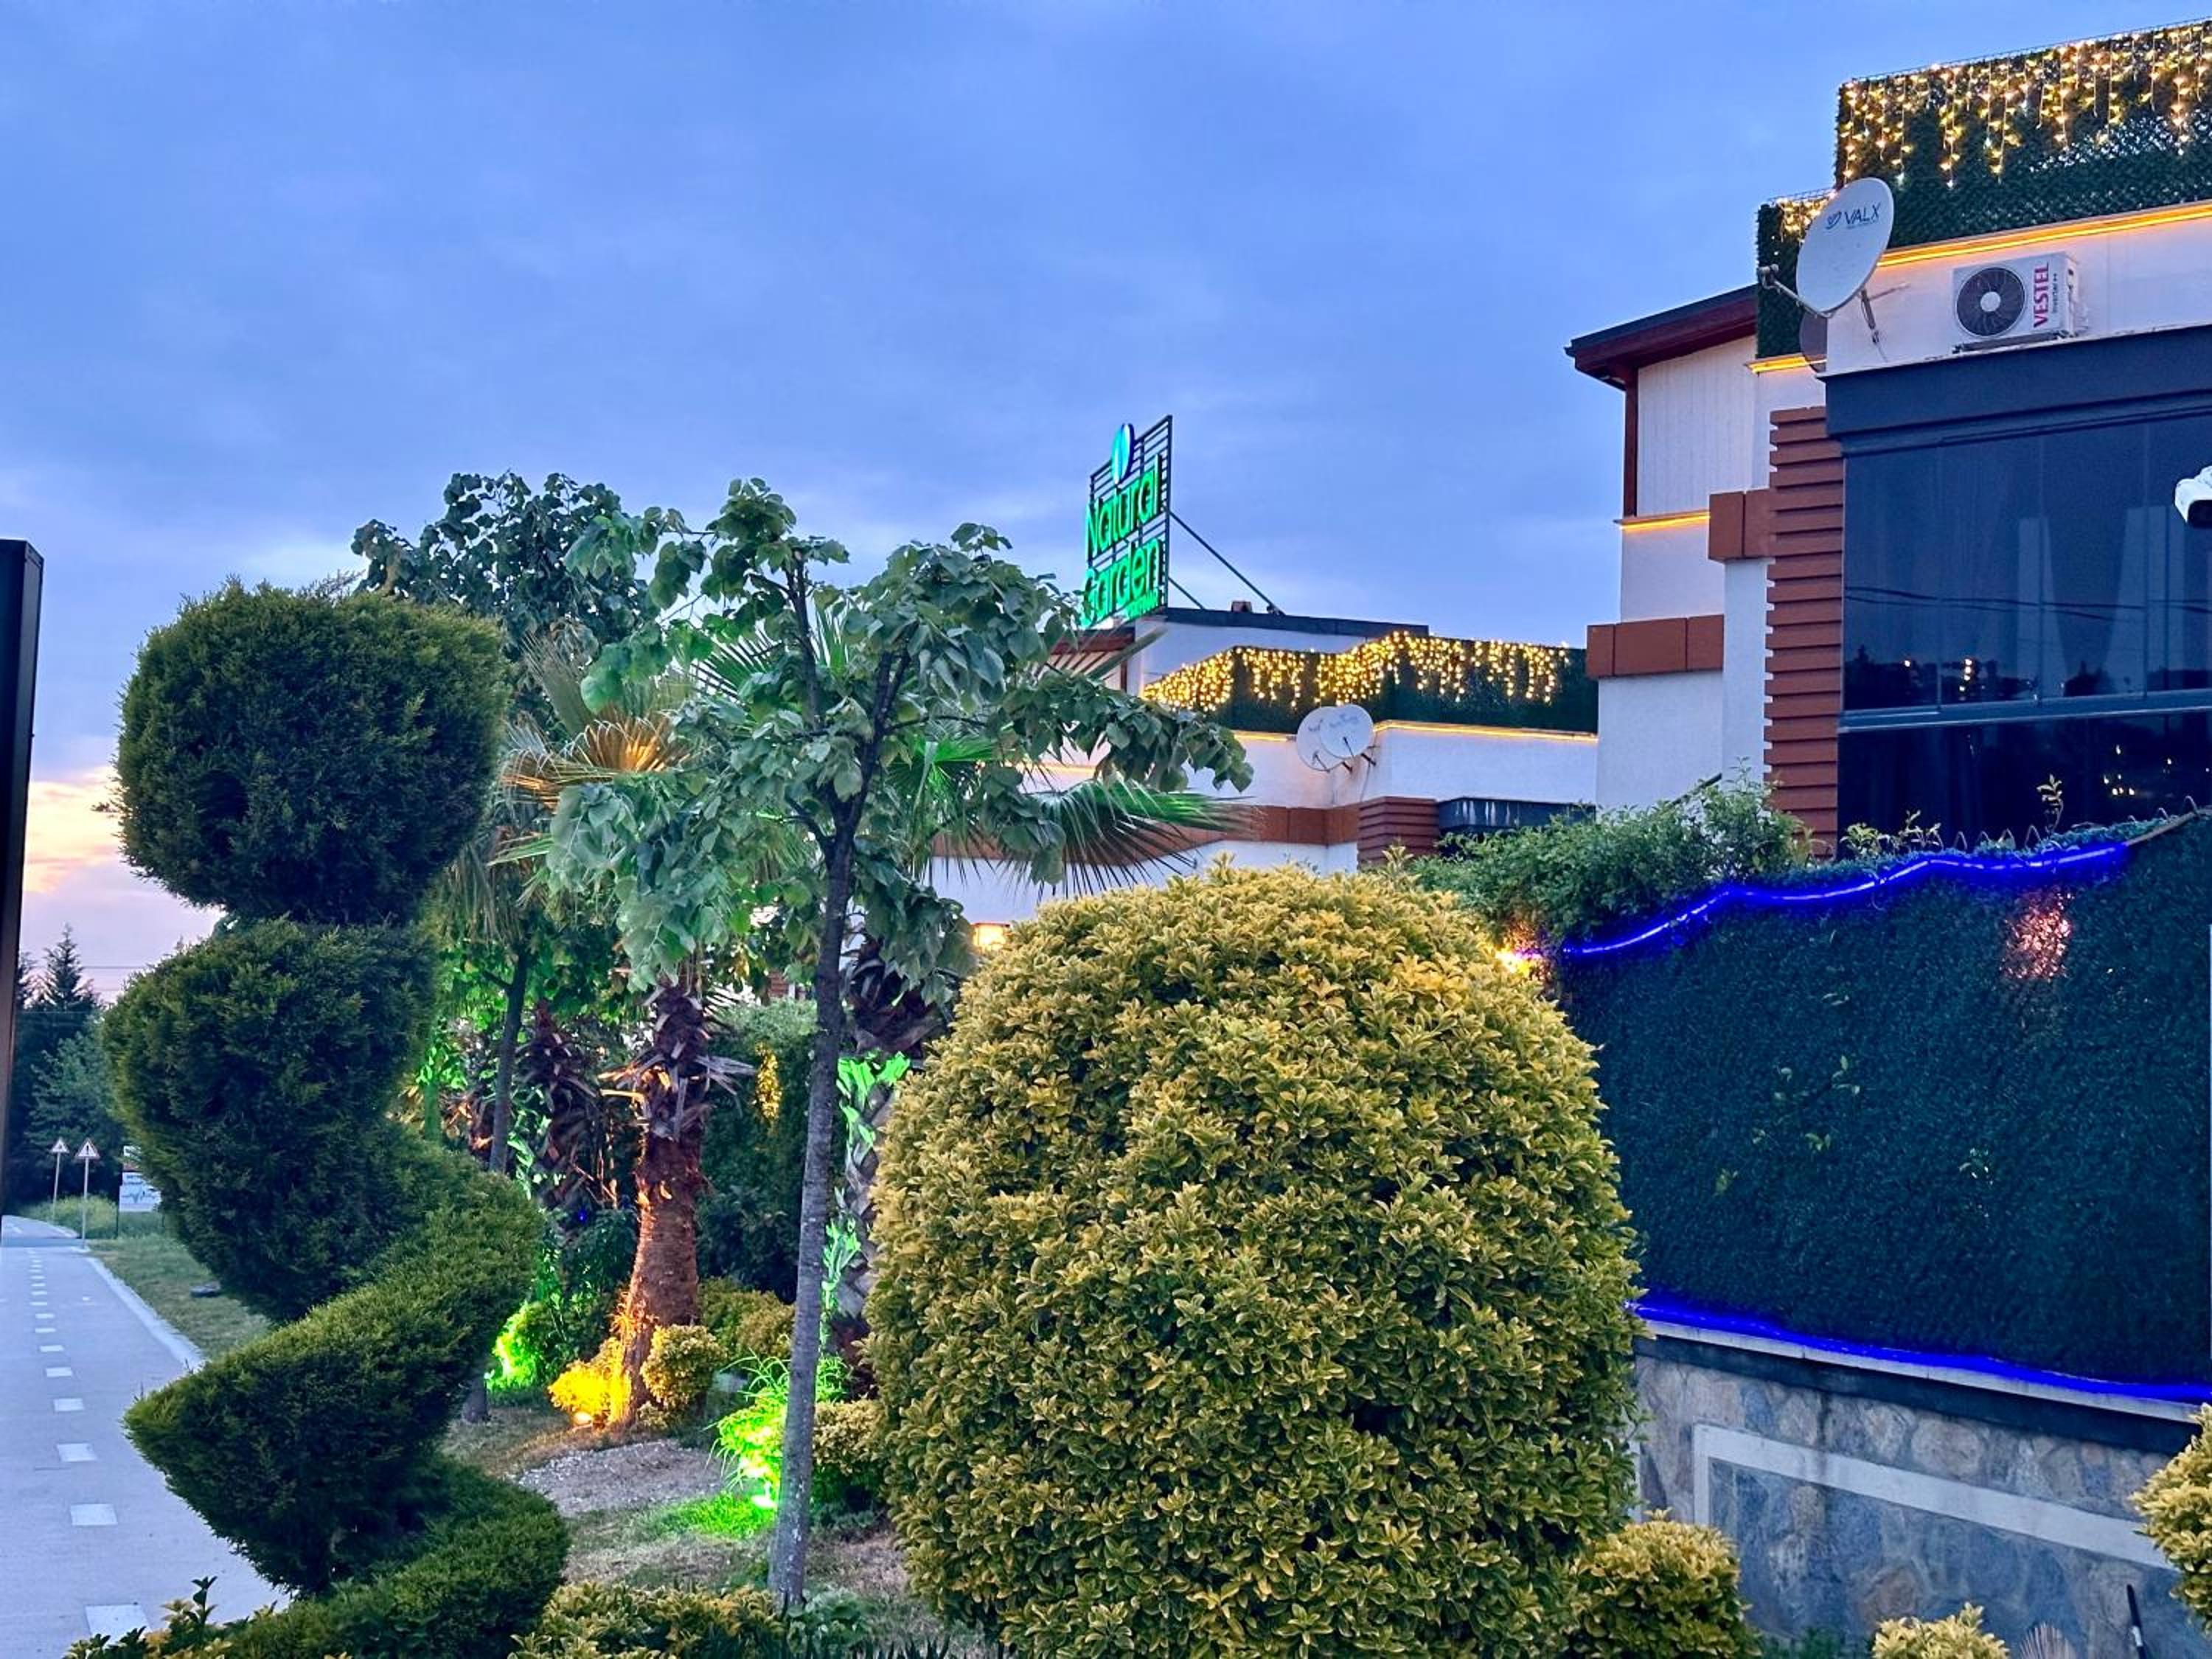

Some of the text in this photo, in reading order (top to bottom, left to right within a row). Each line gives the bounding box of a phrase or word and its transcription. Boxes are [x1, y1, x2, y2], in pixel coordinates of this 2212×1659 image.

[2034, 262, 2049, 328] VESTEL
[1086, 453, 1161, 557] Natural
[1079, 538, 1161, 629] Garden
